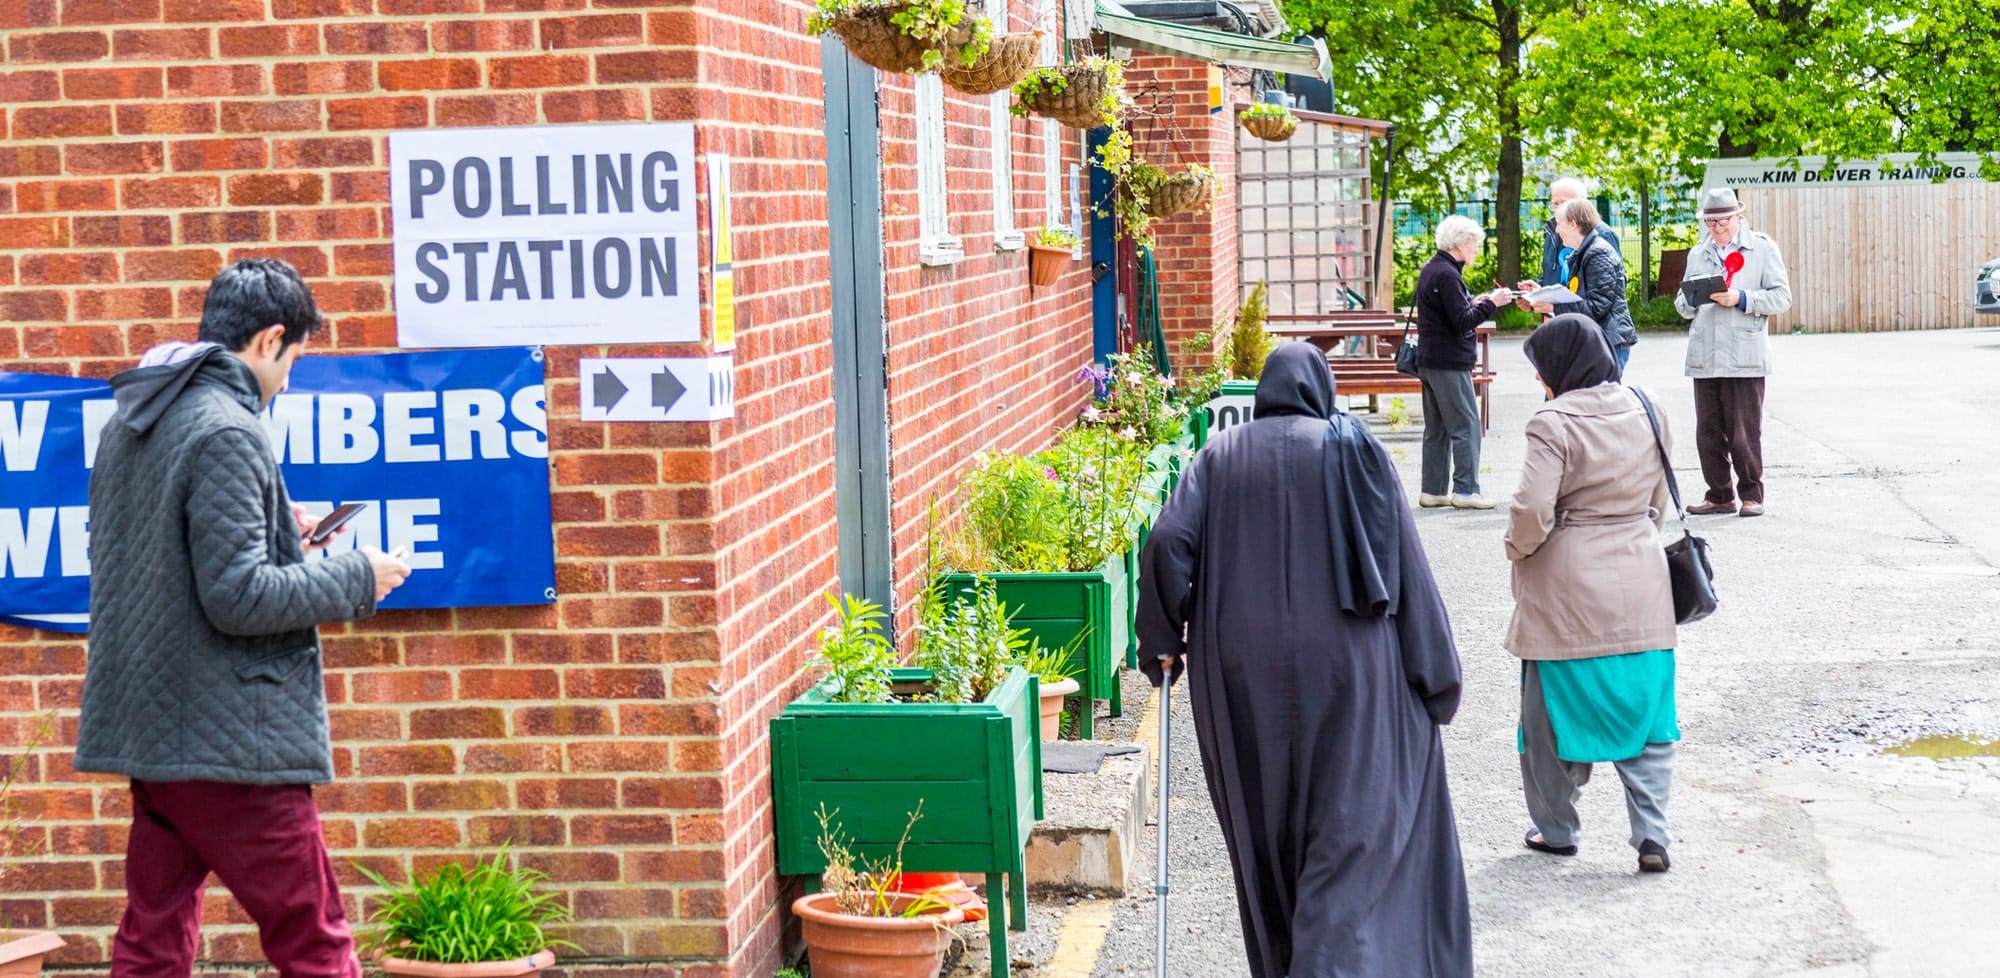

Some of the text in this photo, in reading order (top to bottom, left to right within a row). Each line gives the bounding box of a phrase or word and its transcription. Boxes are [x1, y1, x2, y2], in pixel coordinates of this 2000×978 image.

[408, 150, 680, 219] POLLING
[1726, 170, 1797, 184] www.KIM
[414, 236, 679, 304] STATION
[82, 384, 548, 469] MBERS
